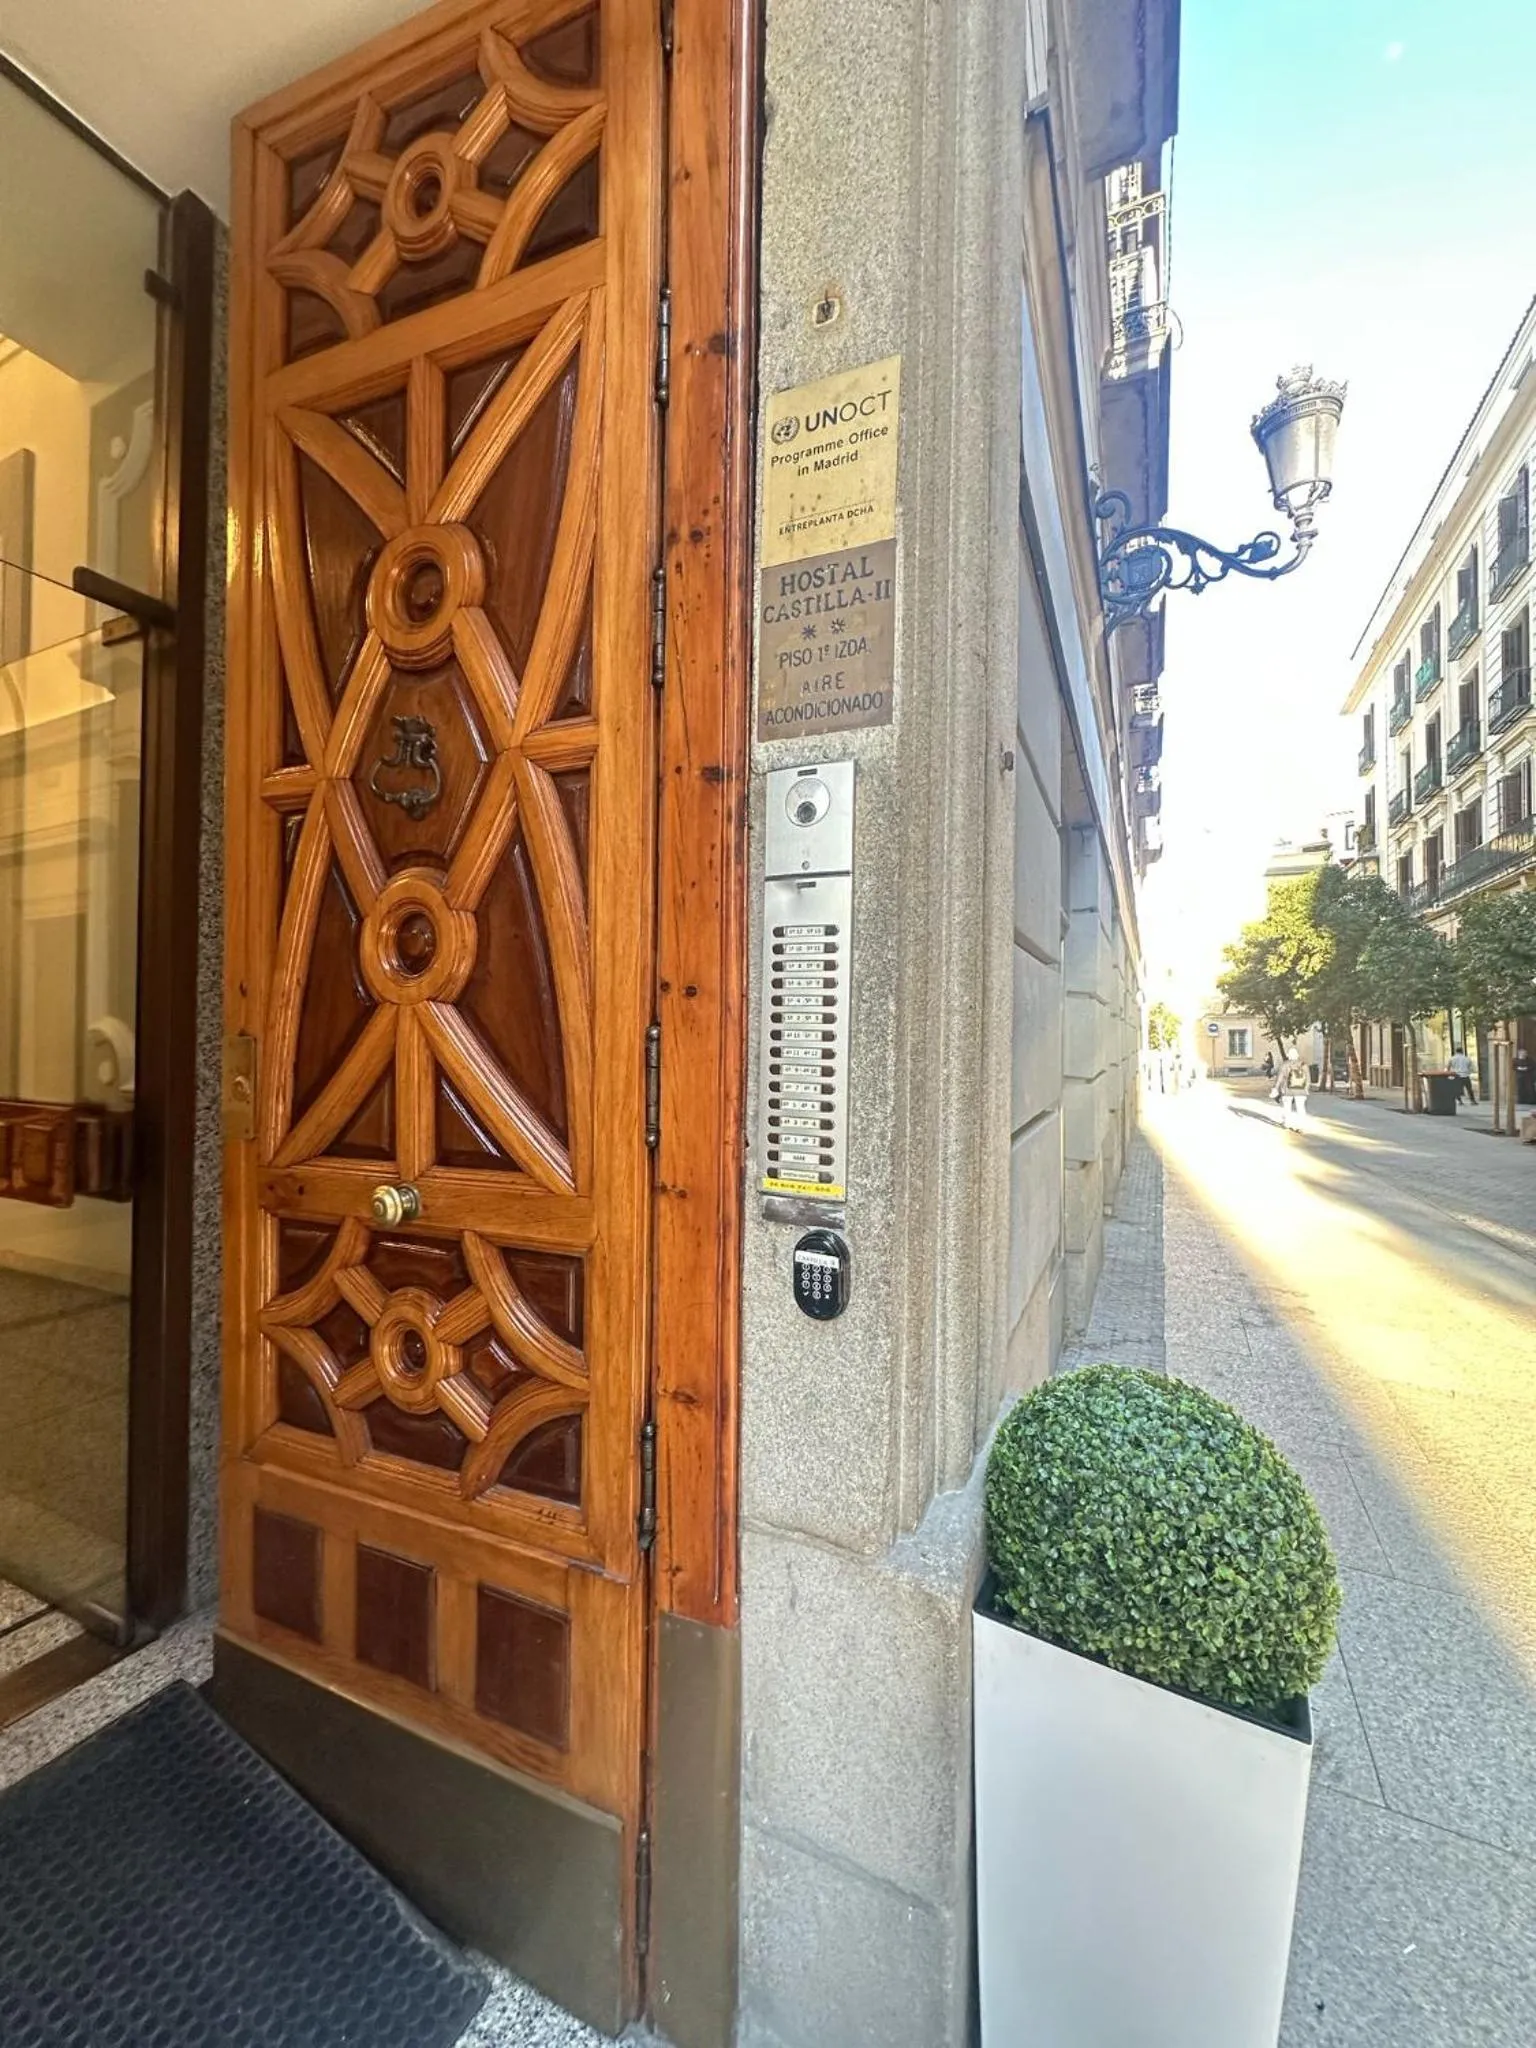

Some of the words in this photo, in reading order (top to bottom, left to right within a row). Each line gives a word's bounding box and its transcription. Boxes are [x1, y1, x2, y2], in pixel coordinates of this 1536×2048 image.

[805, 390, 892, 432] UNOCT
[771, 438, 844, 467] Programme
[849, 426, 888, 446] Office
[797, 464, 809, 476] in
[813, 450, 859, 472] Madrid
[779, 512, 845, 536] ENTREPLANTA
[847, 504, 874, 519] DCHA
[780, 556, 874, 597] HOSTAL
[779, 647, 812, 669] PISO
[802, 672, 845, 694] AIRE
[765, 691, 884, 726] ACONDICIONADO
